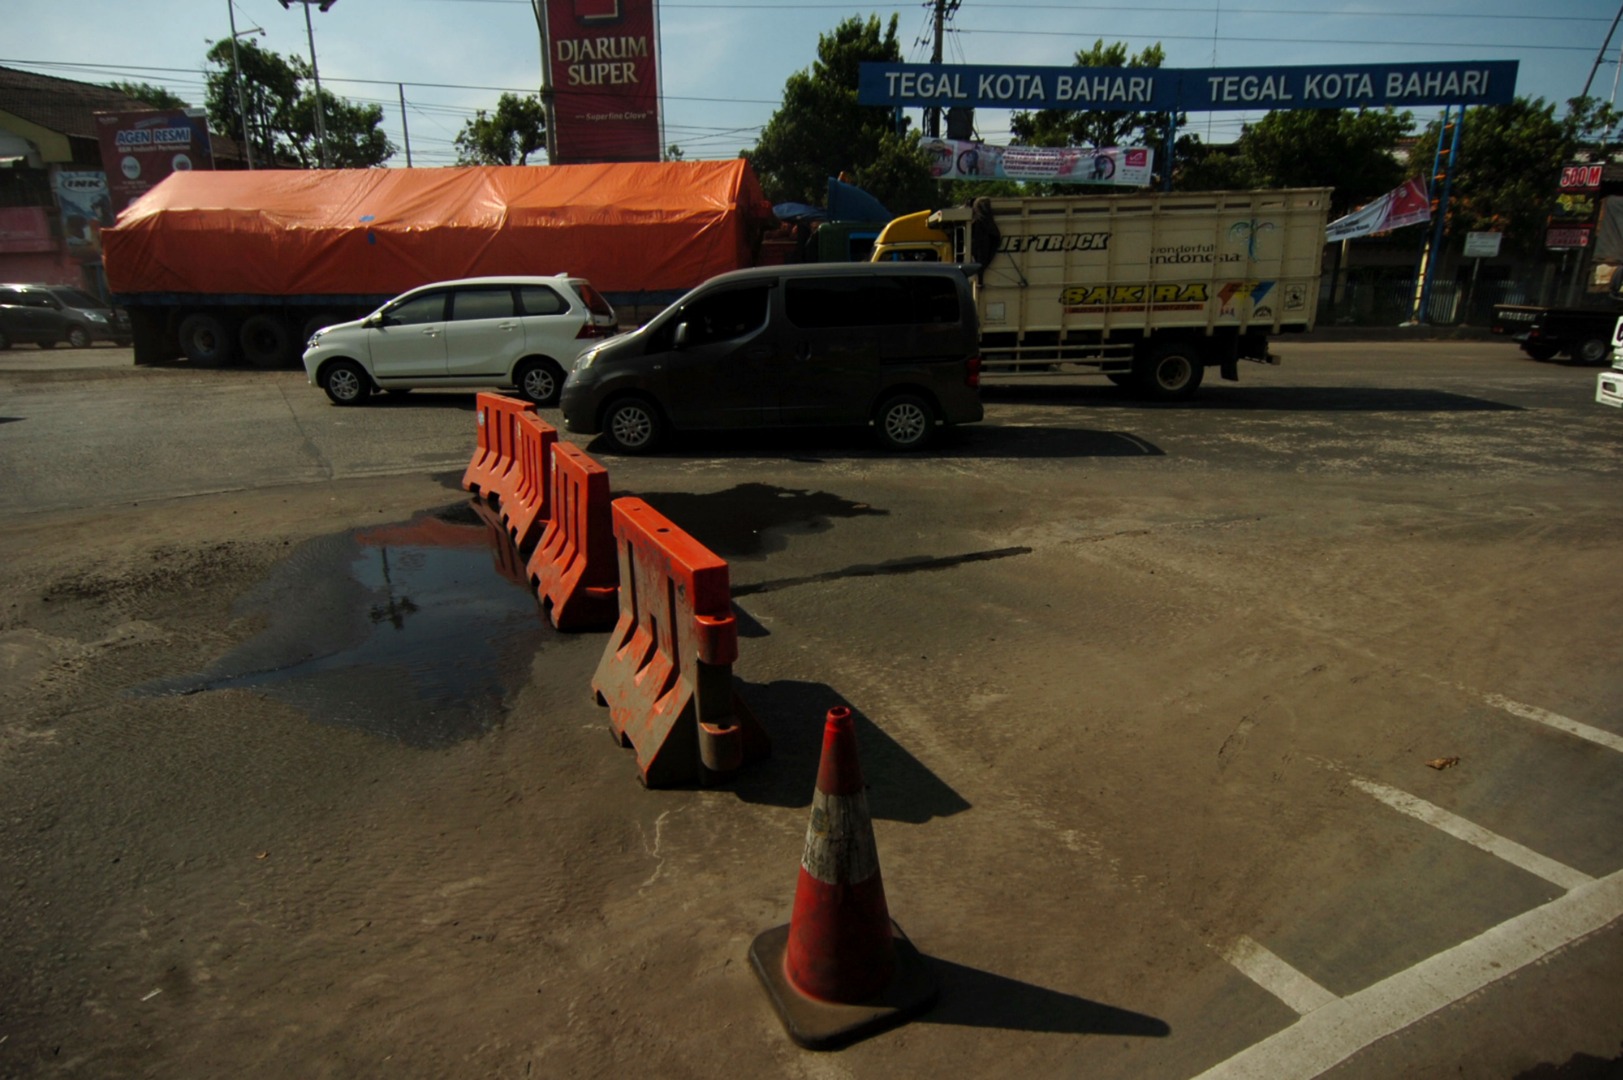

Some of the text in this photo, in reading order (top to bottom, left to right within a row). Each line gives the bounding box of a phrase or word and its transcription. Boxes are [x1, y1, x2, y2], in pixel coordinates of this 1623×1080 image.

[556, 36, 648, 63] DJARUM
[567, 62, 639, 85] SUPER
[885, 72, 1154, 102] TEGAL KOTA BAHARI
[1207, 70, 1490, 102] TEGAL KOTA BAHARI
[115, 127, 191, 145] AGEN RESMI
[67, 180, 100, 188] INK
[1587, 165, 1603, 187] M
[996, 232, 1110, 253] JET TRUCK
[1059, 285, 1207, 304] SAKIRA
